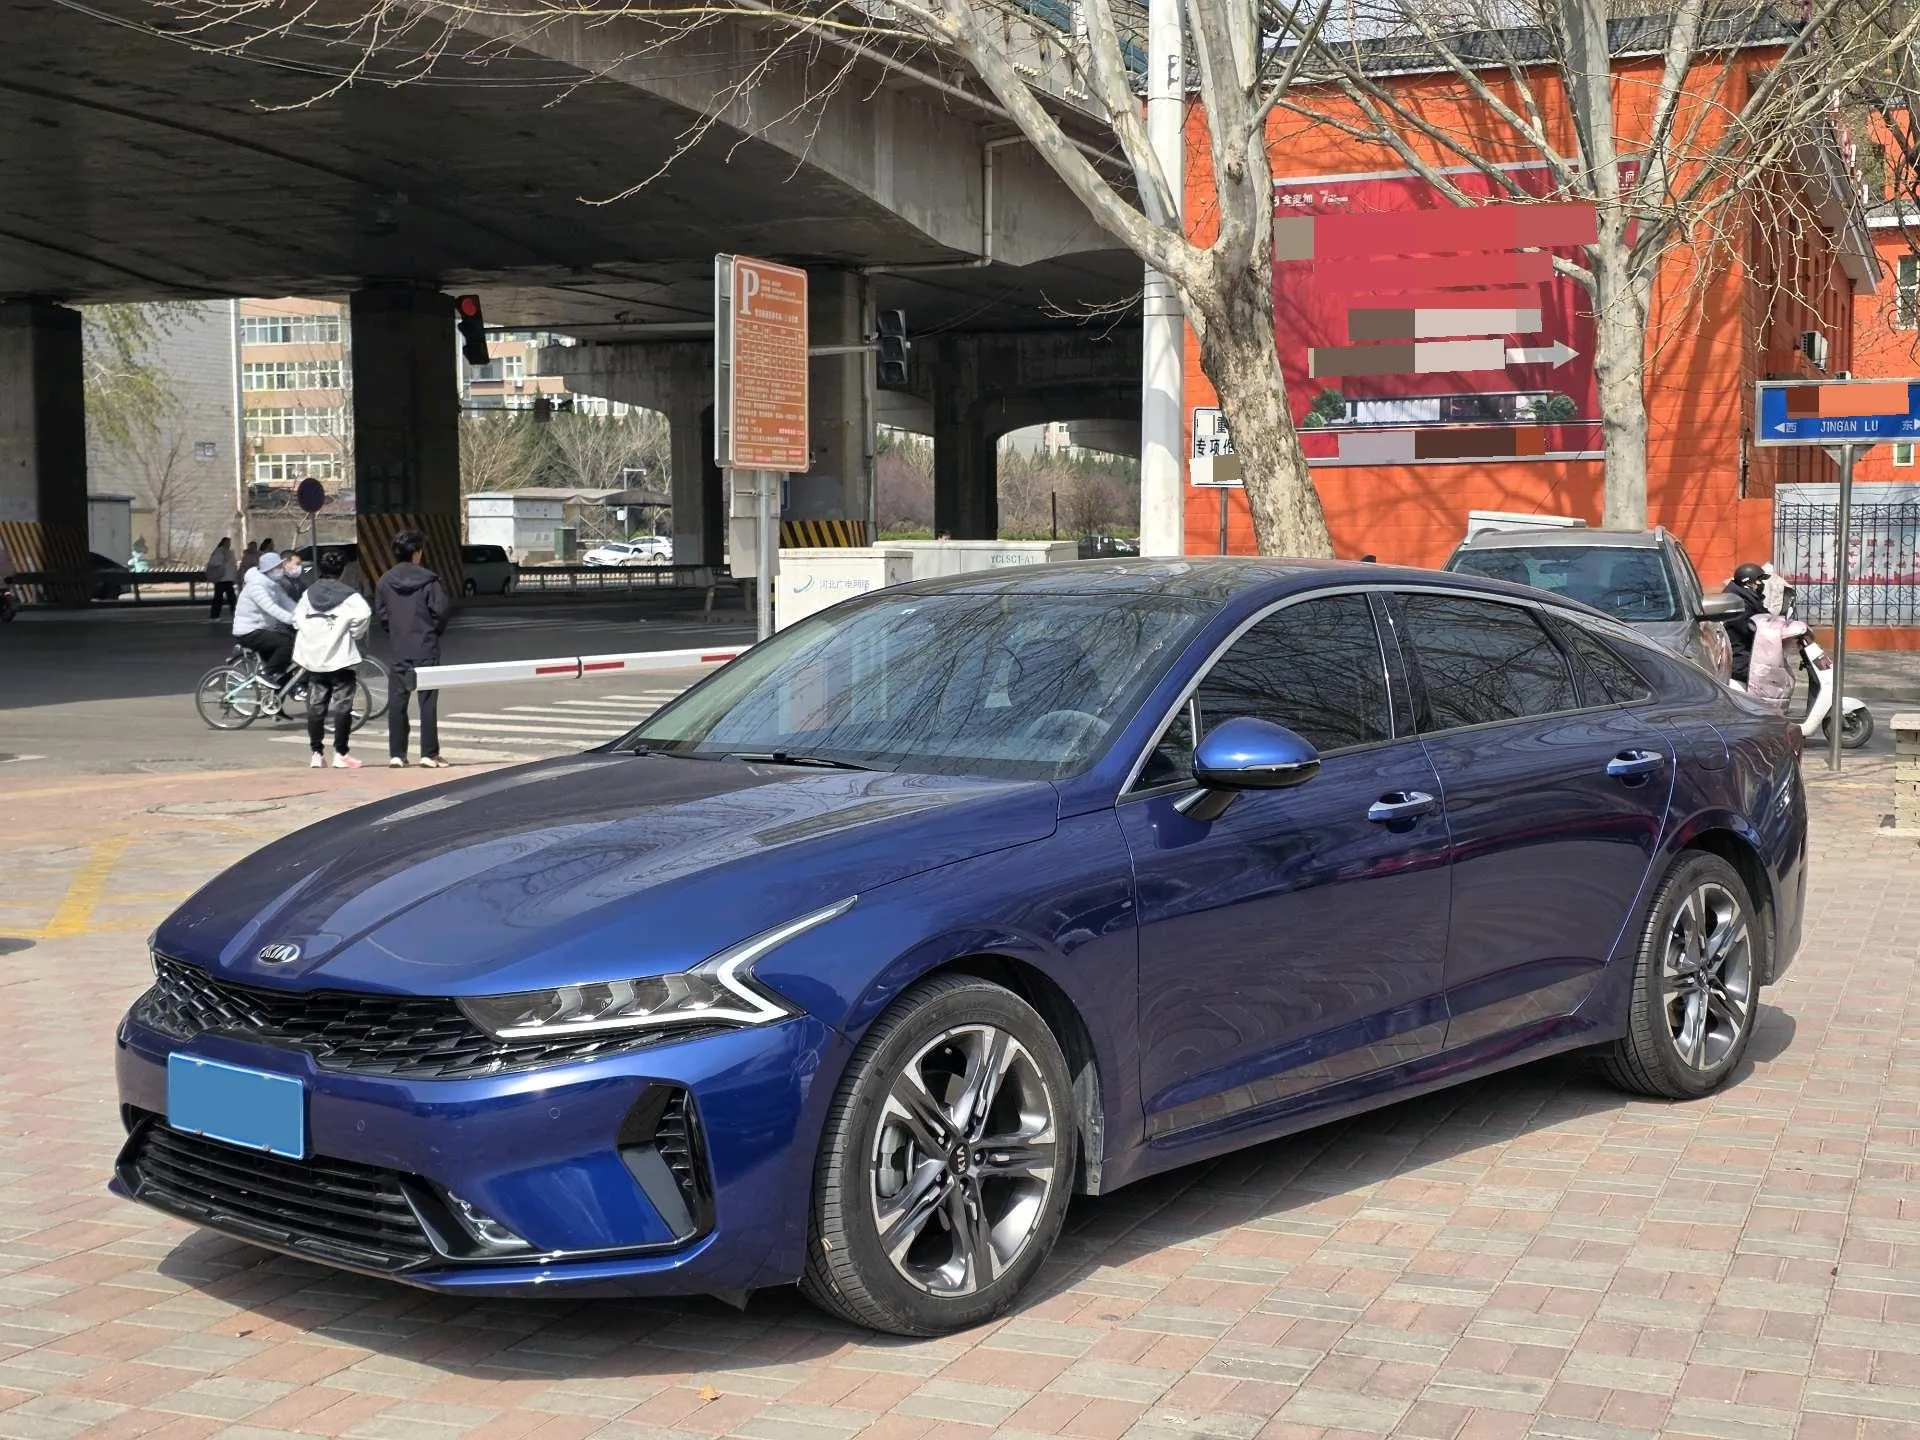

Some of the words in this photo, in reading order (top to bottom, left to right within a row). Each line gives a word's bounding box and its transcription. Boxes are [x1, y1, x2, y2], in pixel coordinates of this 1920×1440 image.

[740, 267, 760, 316] P
[1819, 420, 1857, 433] JINGAN
[1864, 420, 1880, 432] LU
[259, 943, 296, 961] KIA
